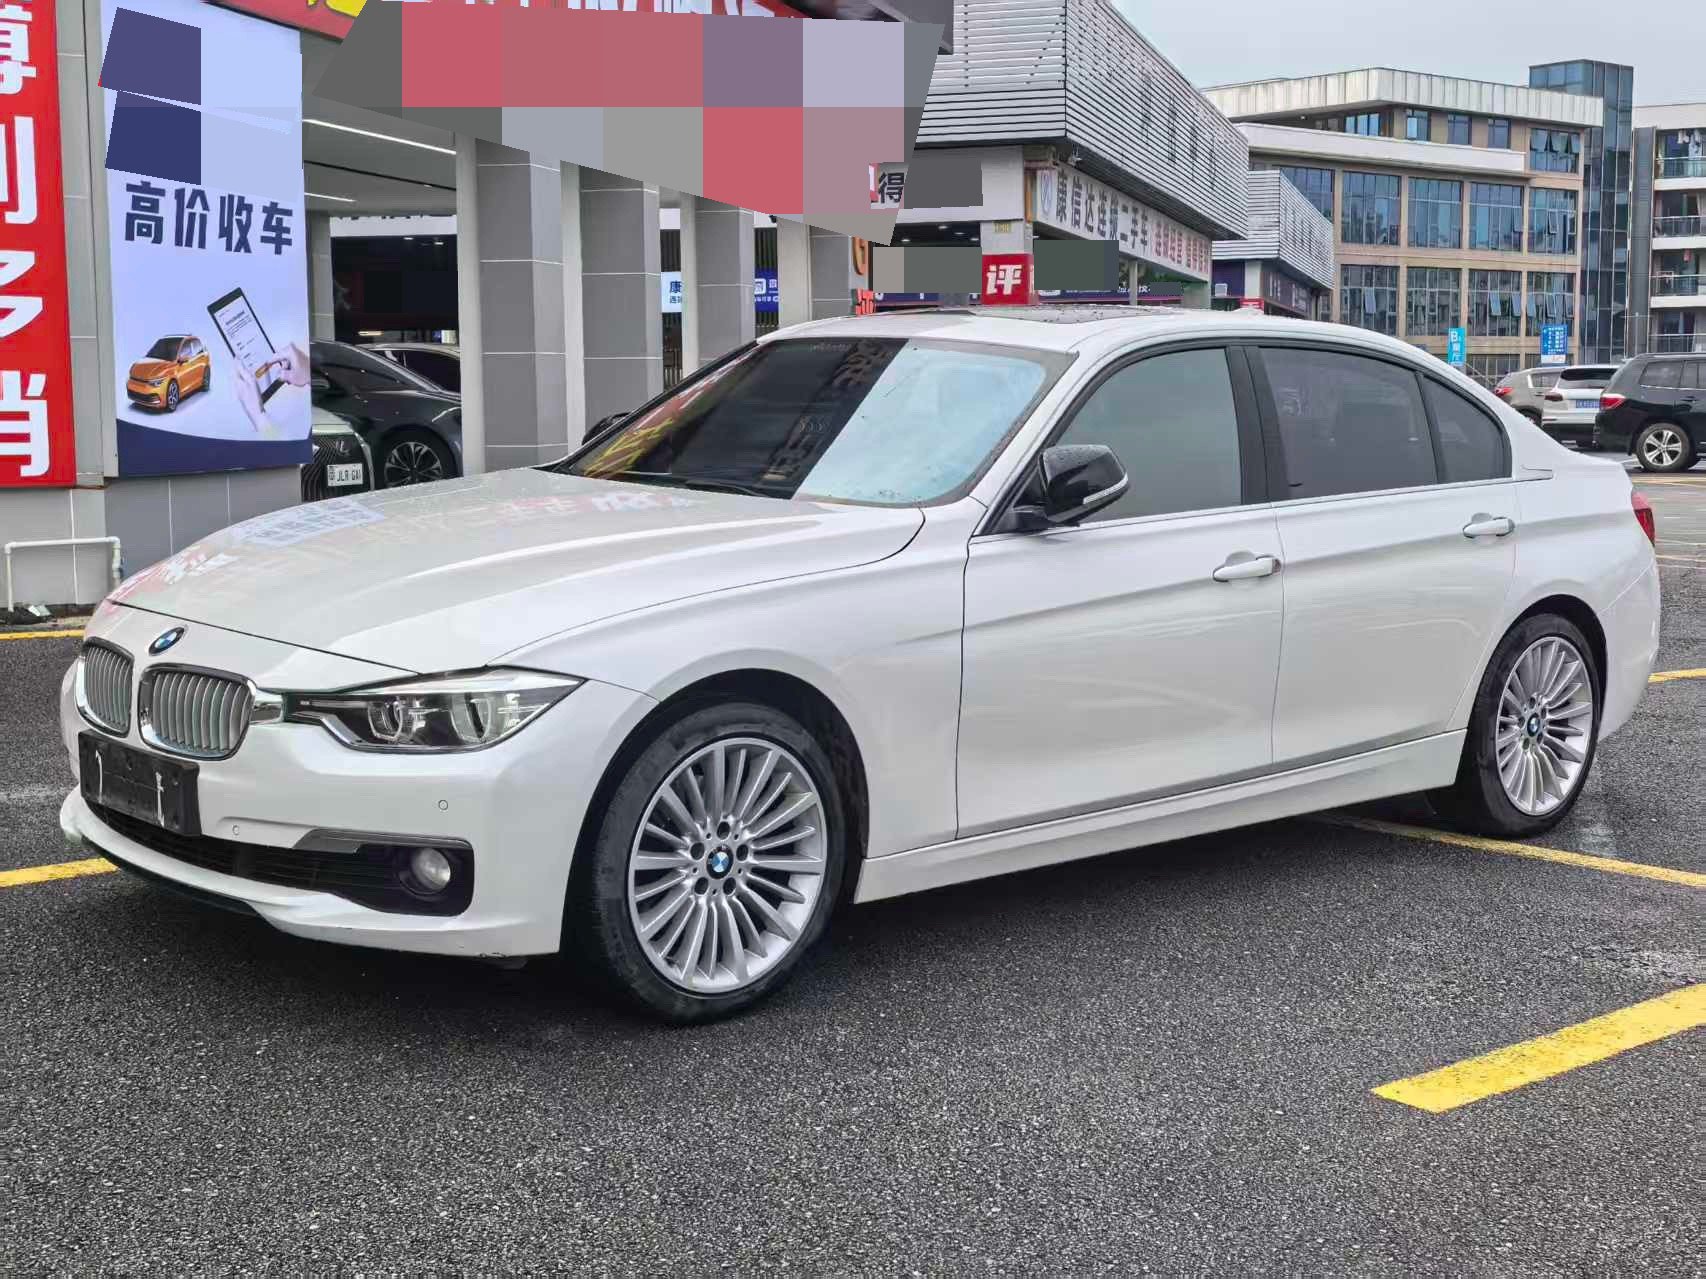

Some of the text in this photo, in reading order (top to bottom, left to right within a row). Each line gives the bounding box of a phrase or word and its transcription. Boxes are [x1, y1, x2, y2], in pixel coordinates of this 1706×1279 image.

[878, 172, 905, 204] 得
[125, 181, 293, 256] 高价收车
[986, 263, 1022, 296] 评
